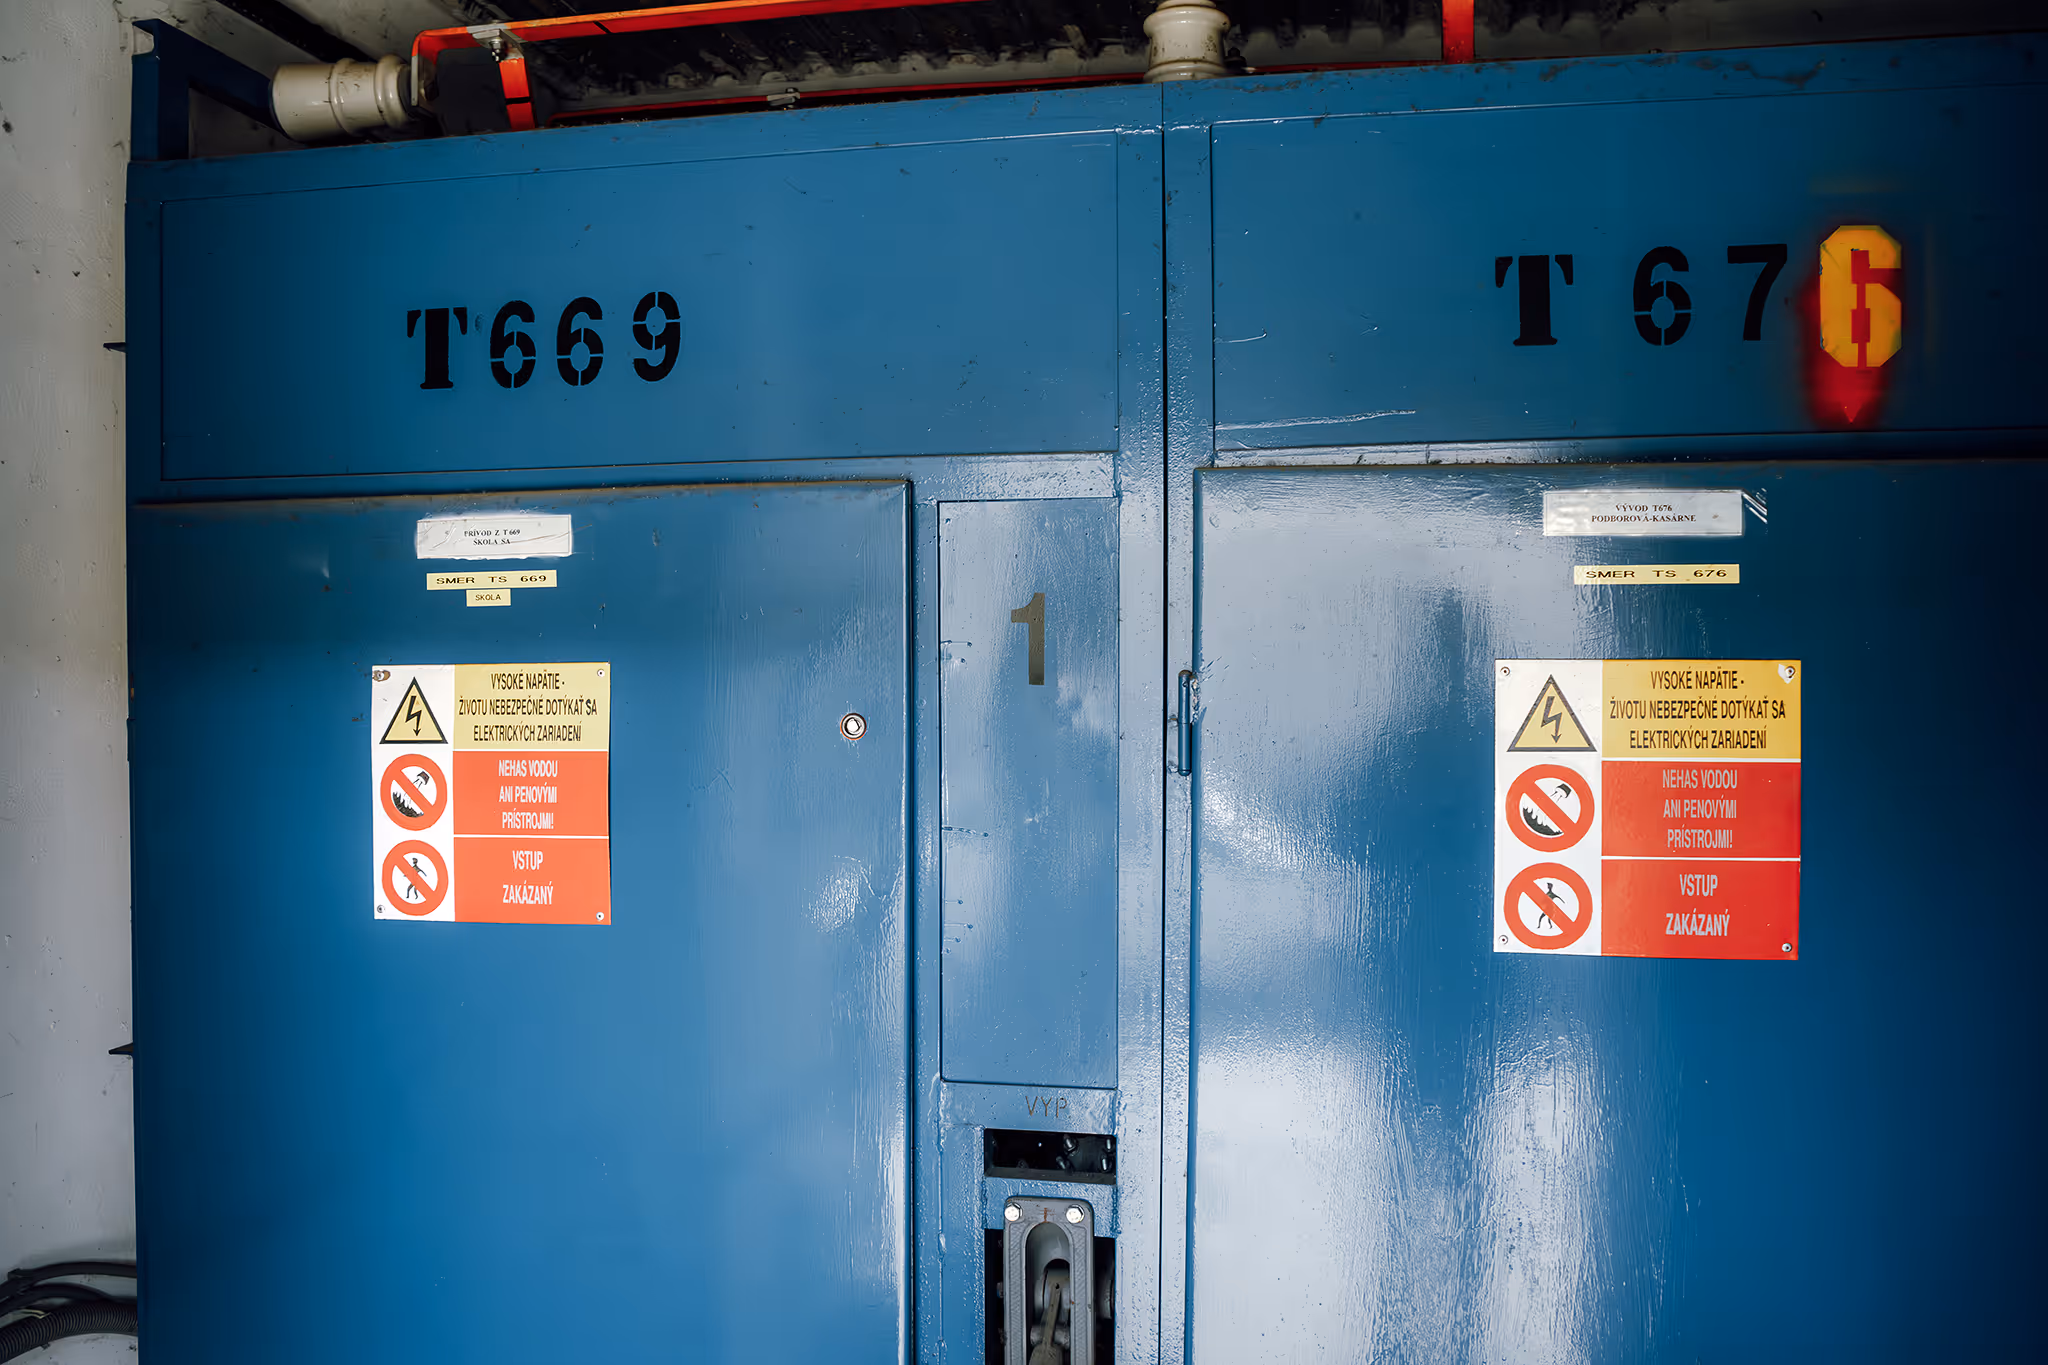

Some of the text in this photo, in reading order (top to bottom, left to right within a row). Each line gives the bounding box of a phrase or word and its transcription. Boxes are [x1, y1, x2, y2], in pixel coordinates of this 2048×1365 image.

[1615, 503, 1648, 511] VÝVOD
[436, 574, 547, 585] SMER TS 669
[1586, 569, 1727, 578] SMER TS 676
[1010, 592, 1046, 685] 1
[491, 669, 523, 690] VYSOKÉ
[525, 669, 560, 690] NAPÄTIE
[1650, 666, 1692, 689] VYSOKÉ
[1695, 666, 1738, 689] NAPÄTIE
[458, 694, 598, 716] ŽIVOTU NEBEZPEČNÉ DOTÝKAŤ SA
[1610, 695, 1786, 719] ŽIVOTU NEBEZPEČNÉ DOTÝKAŤ SA
[473, 720, 582, 742] ELEKTRICKÝCH ZARIADENÍ
[1630, 725, 1767, 749] ELEKTRICKÝCH ZARIADENÍ
[498, 759, 558, 777] NEHAS VODOU
[1662, 768, 1738, 790] NEHAS VODOU
[499, 782, 557, 803] ANI PENOVÝMI
[1663, 795, 1737, 819] ANI PENOVÝMI
[502, 808, 554, 830] PRÍSTROJMI!
[1667, 824, 1733, 848] PRÍSTROJMI!
[512, 850, 543, 870] VSTUP
[502, 880, 554, 905] ZAKÁZANÝ
[1679, 873, 1718, 897] VSTUP
[1665, 908, 1730, 937] ZAKÁZANÝ
[1025, 1095, 1068, 1118] VYP
